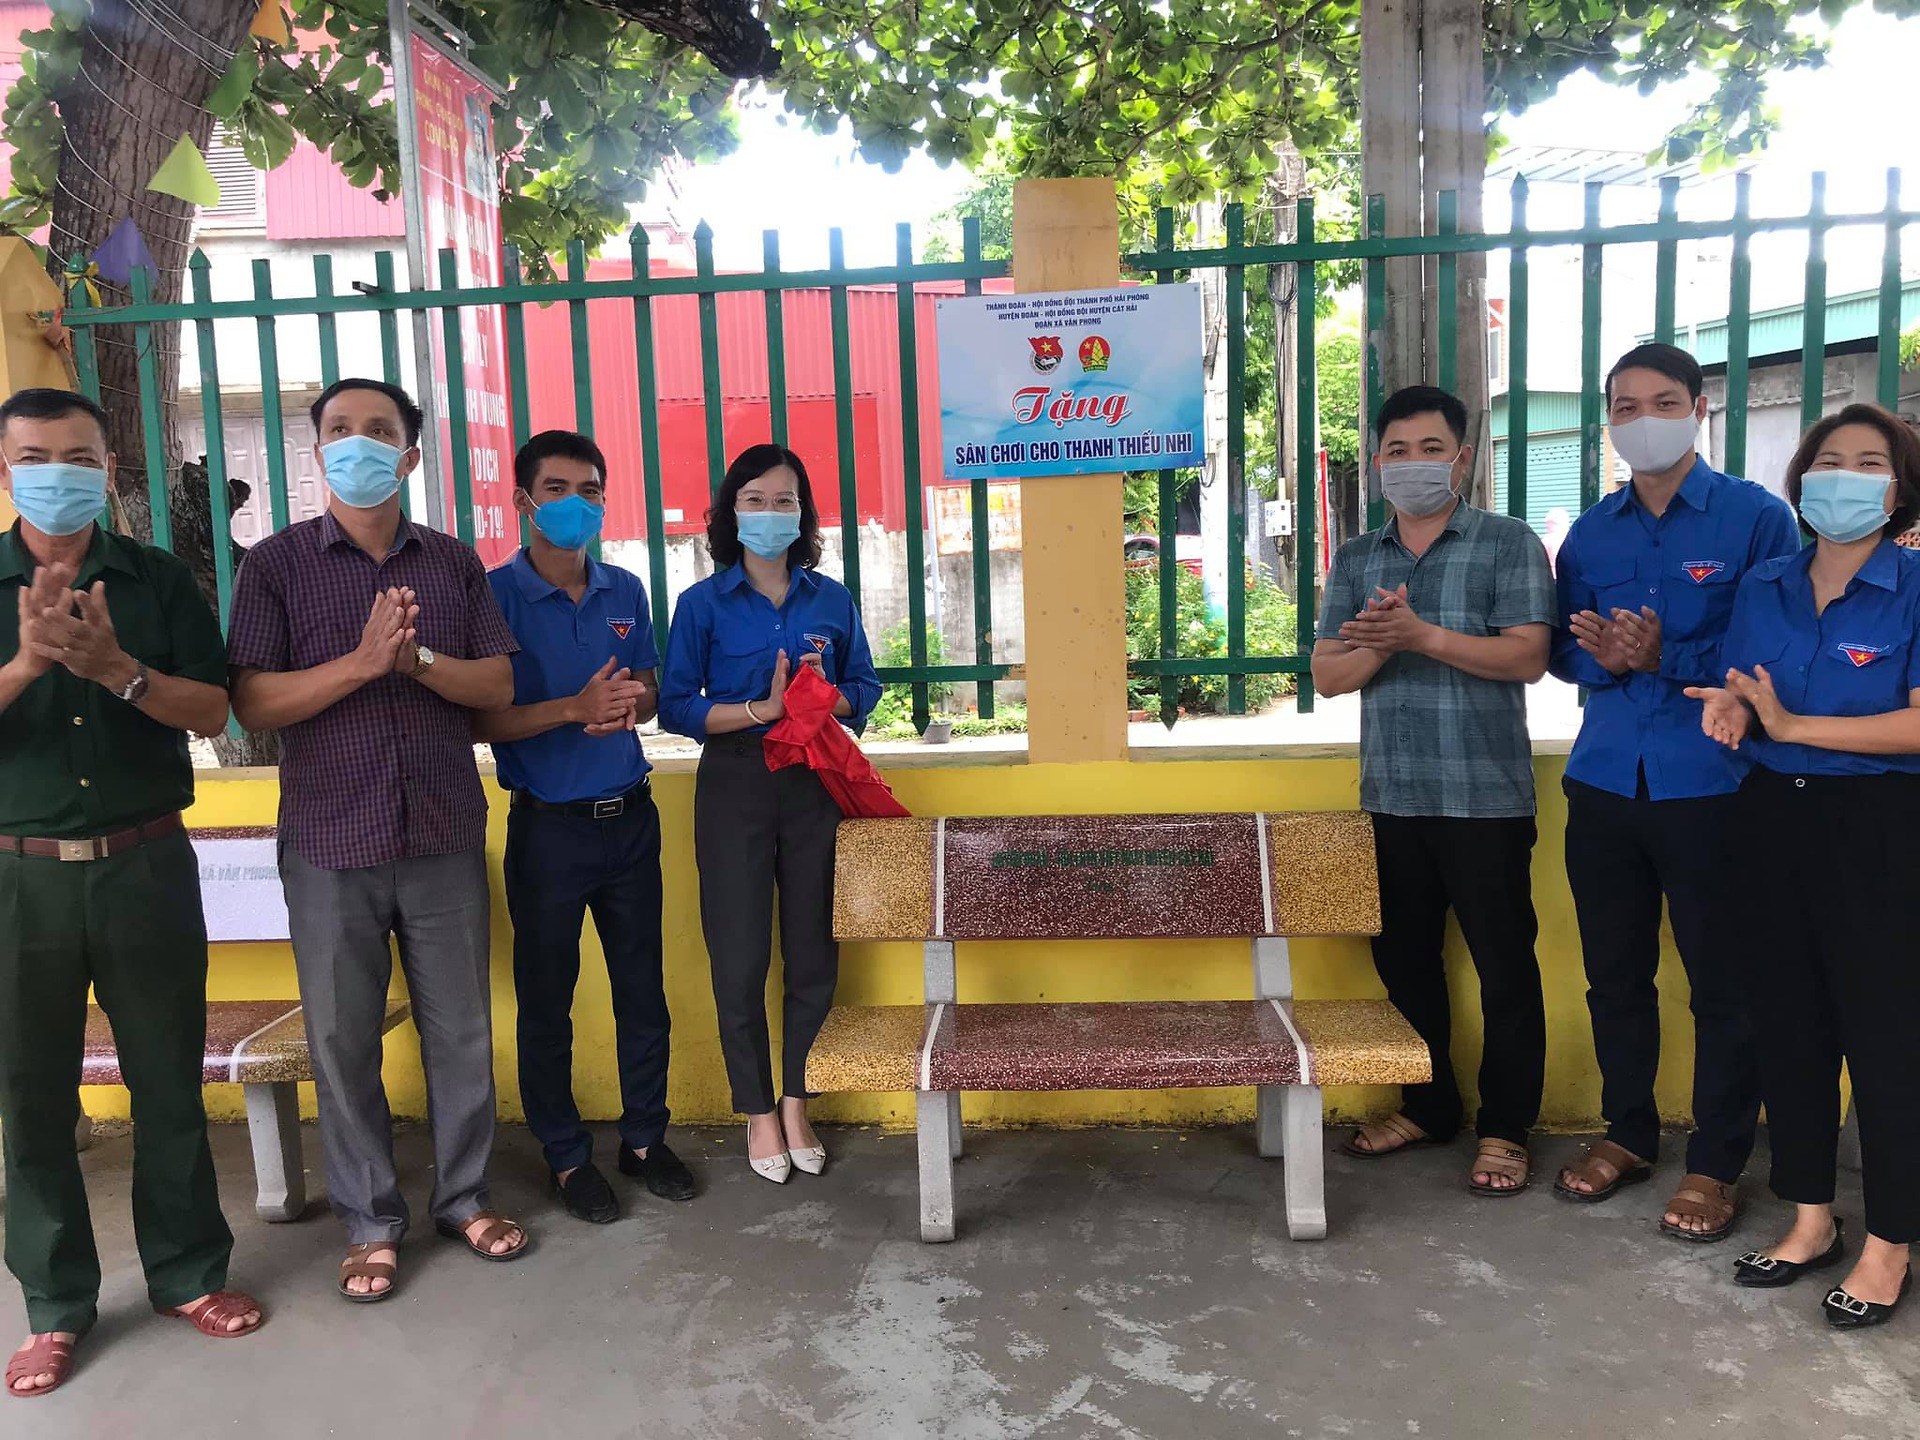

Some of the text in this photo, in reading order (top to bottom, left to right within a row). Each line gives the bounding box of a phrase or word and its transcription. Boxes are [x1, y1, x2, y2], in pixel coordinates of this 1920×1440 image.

[986, 302, 1007, 311] THÀNH
[1008, 301, 1027, 310] ĐOÀN
[1032, 299, 1043, 309] HỘI
[1044, 297, 1063, 307] ĐỒNG
[1076, 296, 1098, 305] THÀNH
[1099, 295, 1113, 304] PHỐ
[1114, 293, 1126, 303] HẢI
[1020, 310, 1039, 319] ĐOÀN
[1044, 309, 1056, 318] HỘI
[1057, 307, 1075, 317] ĐỒNG
[1076, 307, 1088, 316] ĐỘI
[1125, 303, 1138, 312] HẢI
[1034, 319, 1053, 329] ĐOÀN
[1079, 316, 1102, 327] PHONG
[480, 384, 506, 428] VÙNG
[1011, 386, 1131, 428] Tặng
[955, 429, 1193, 466] SÂN CHƠI CHO THANH THIẾU NHI
[473, 446, 500, 489] DỊCH
